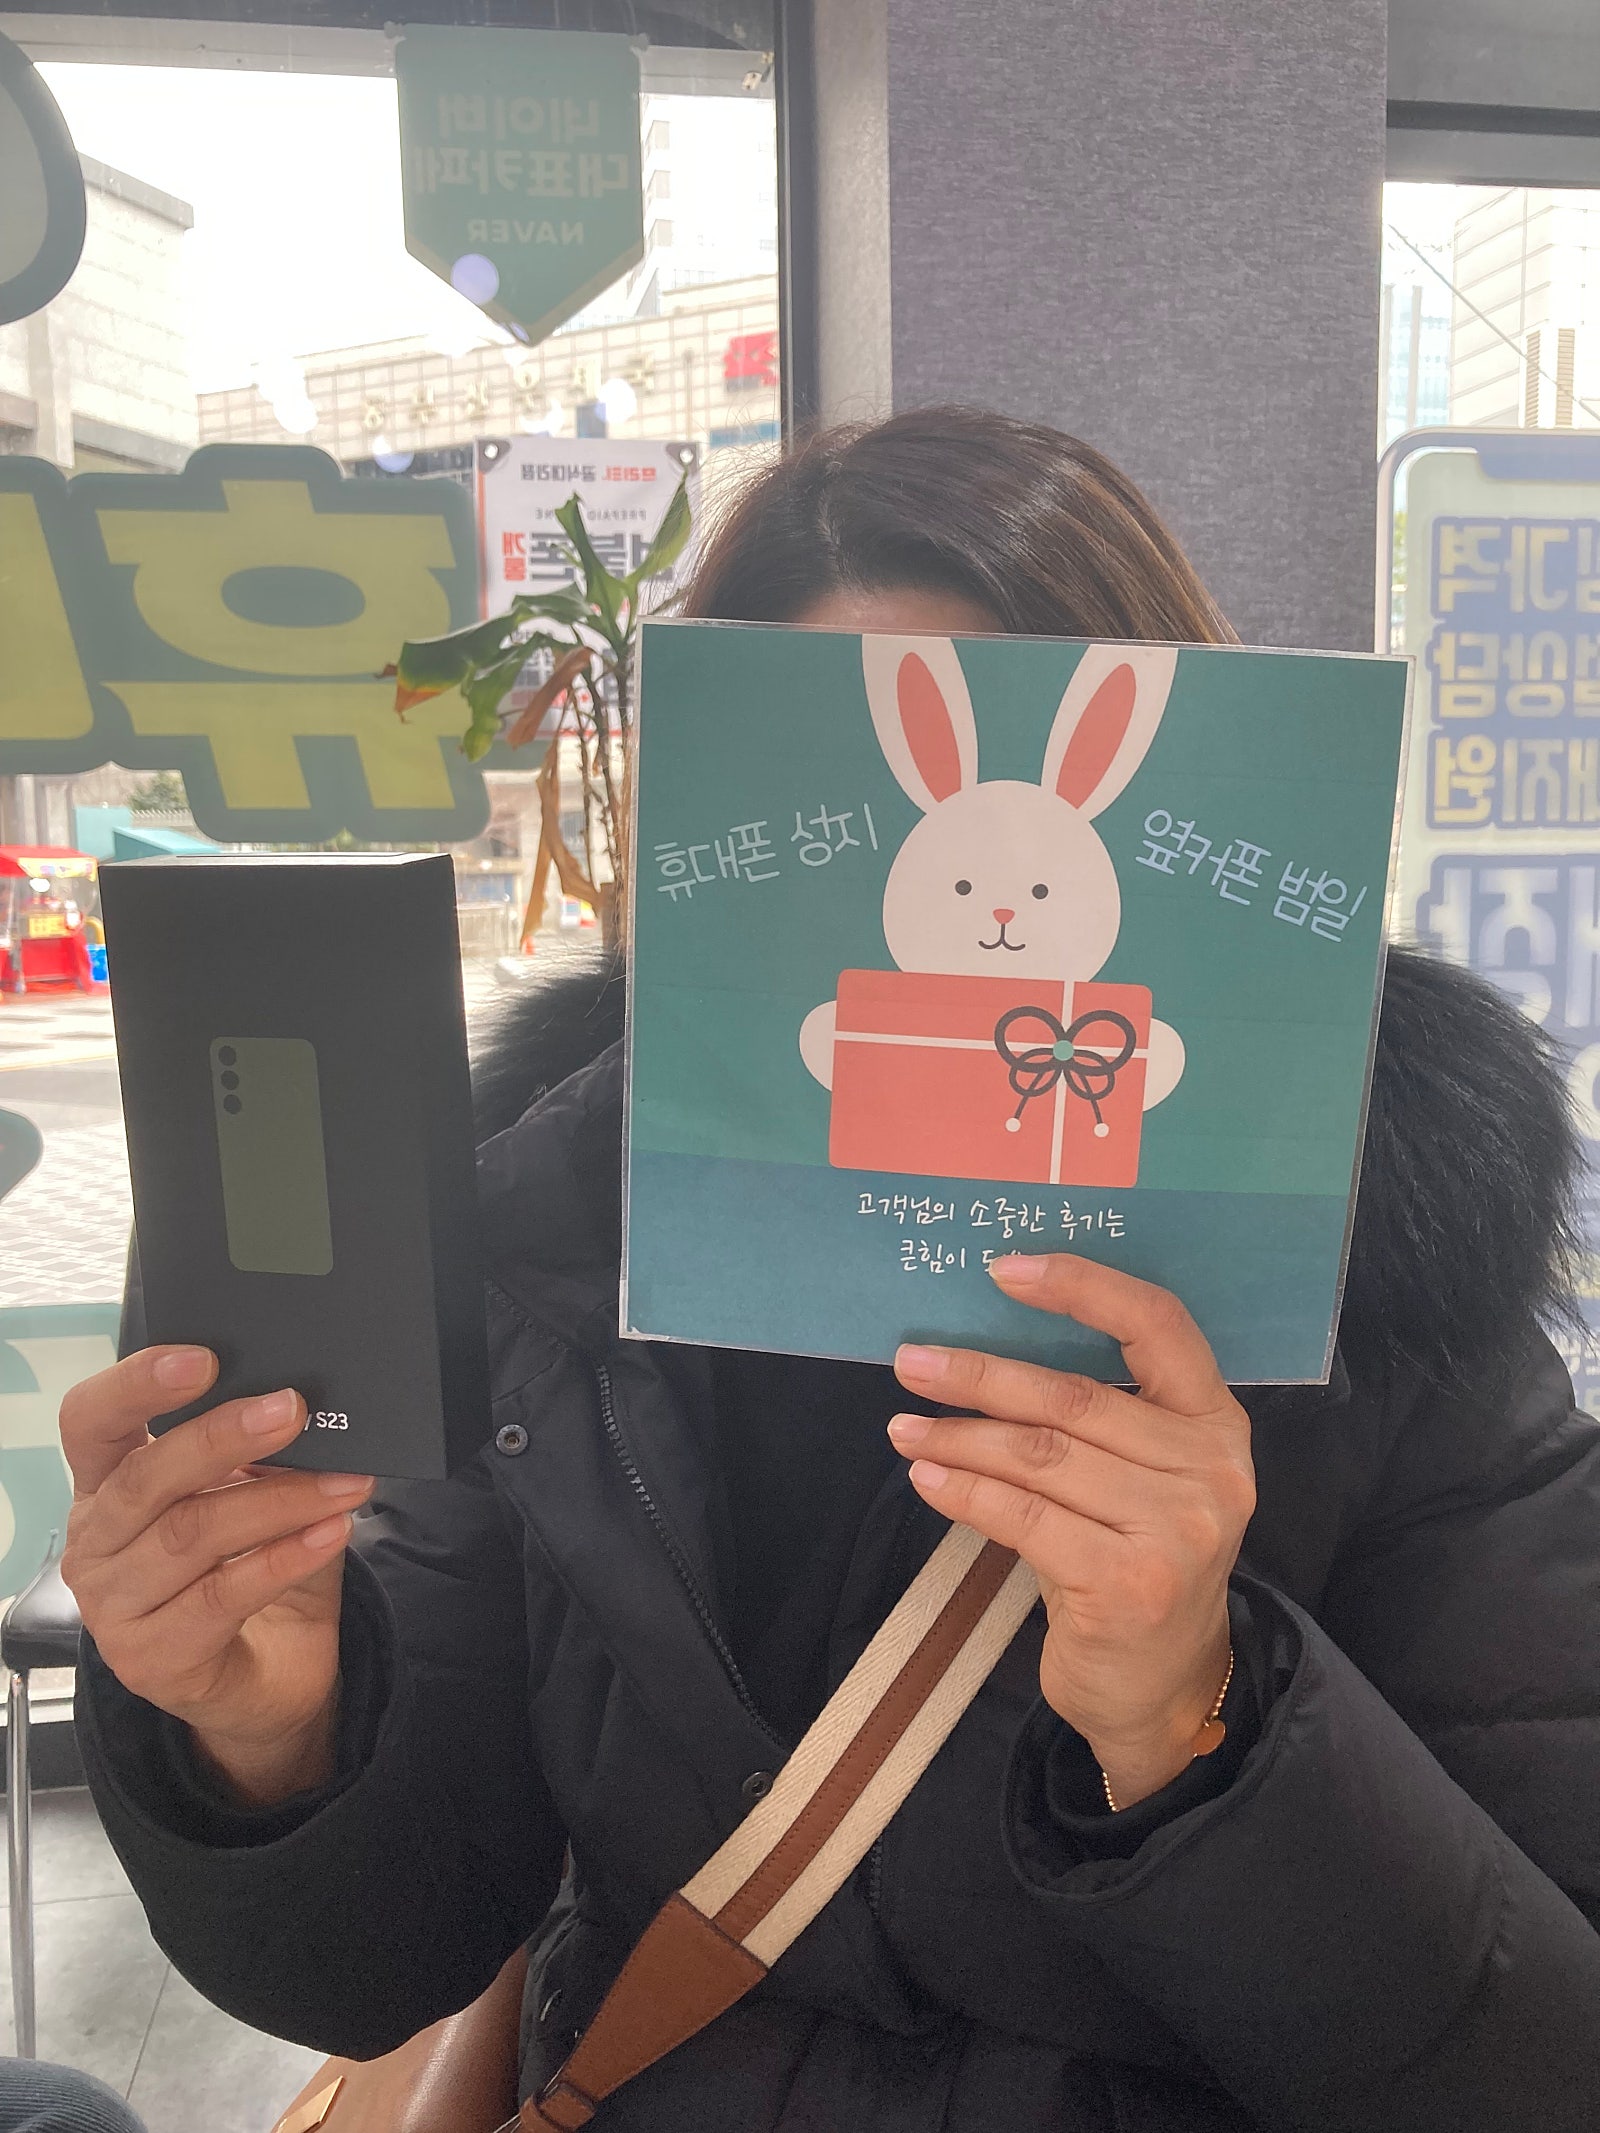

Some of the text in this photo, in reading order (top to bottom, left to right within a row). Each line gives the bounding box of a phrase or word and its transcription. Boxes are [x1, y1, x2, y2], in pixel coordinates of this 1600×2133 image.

[653, 803, 879, 903] 휴대폰 성지
[1135, 809, 1368, 943] 옆커폰 범일
[857, 1192, 1126, 1241] 고객님의 소중한 후기는
[899, 1239, 967, 1274] 큰힘이
[316, 1411, 349, 1431] S23
